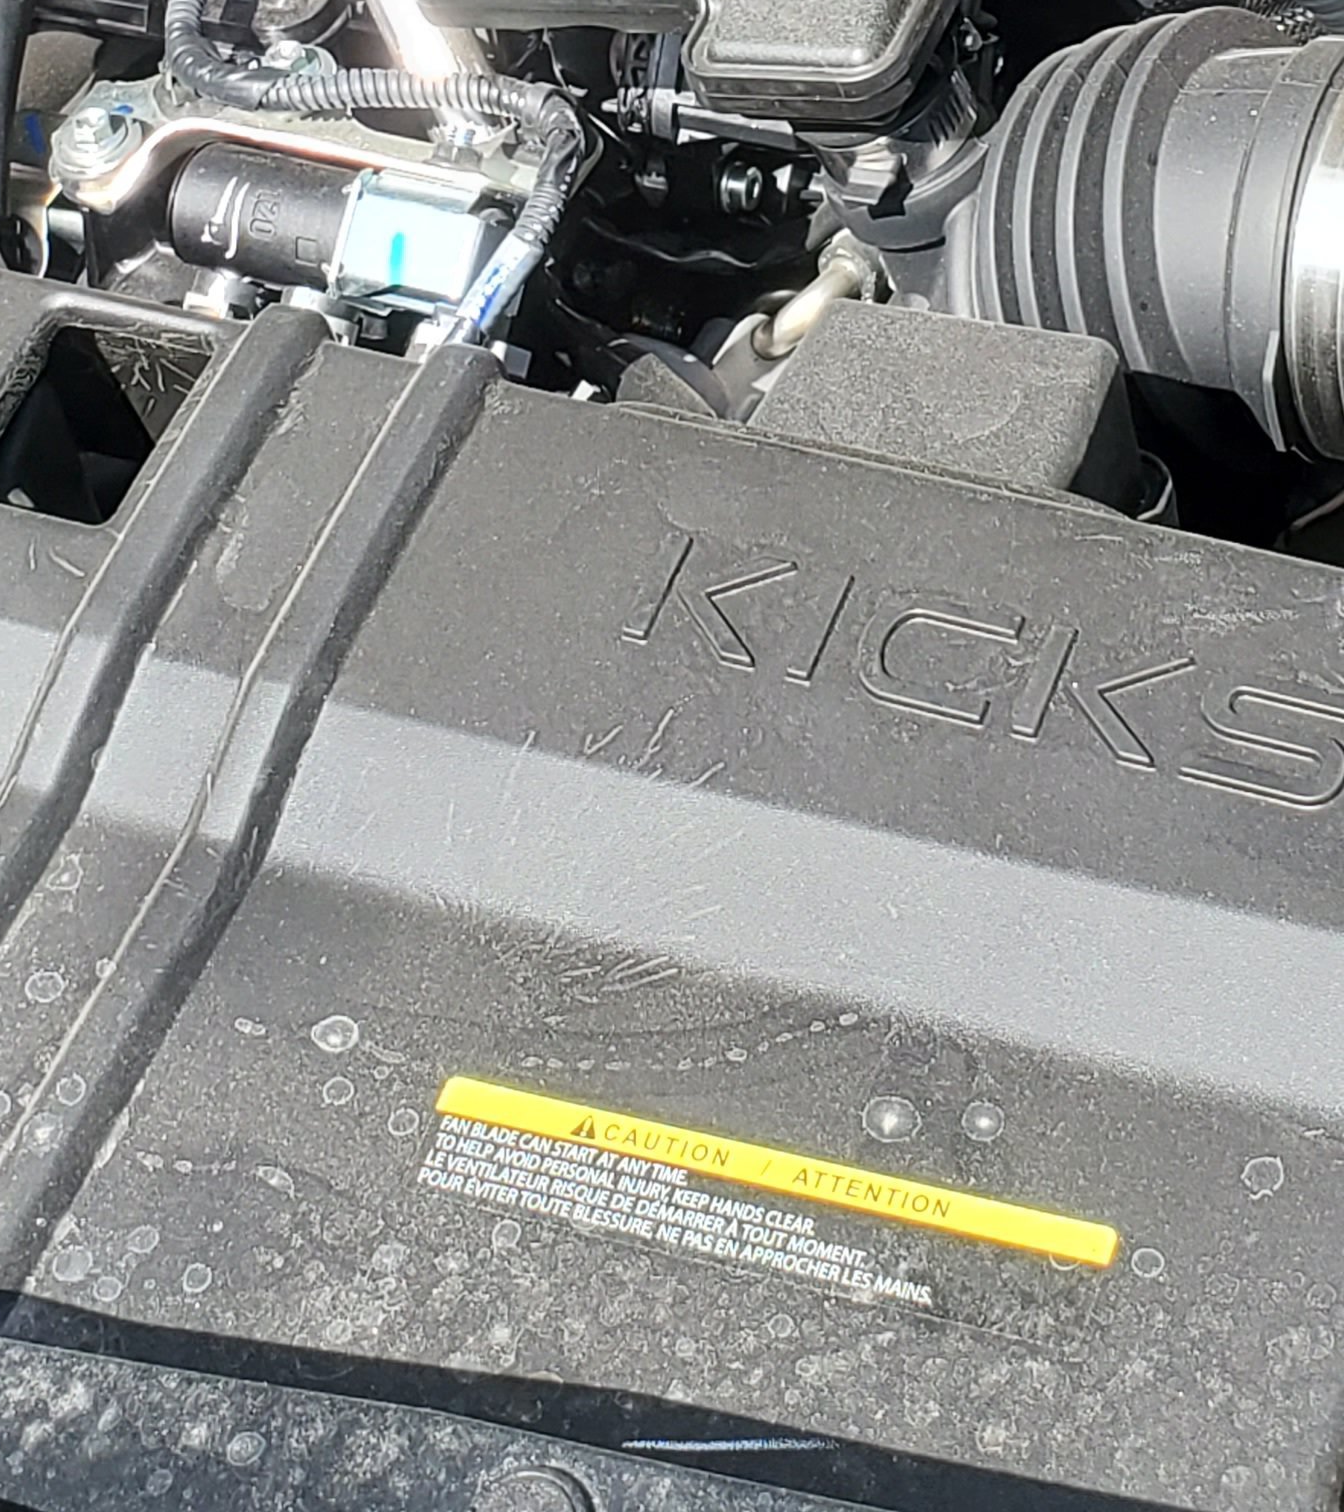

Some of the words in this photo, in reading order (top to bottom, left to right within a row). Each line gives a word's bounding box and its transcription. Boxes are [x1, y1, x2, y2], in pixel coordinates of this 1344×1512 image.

[434, 1131, 457, 1151] TO
[455, 1136, 495, 1160] HELP
[493, 1144, 542, 1171] AVOID
[539, 1155, 617, 1189] PERSONAL
[670, 1185, 711, 1211] KEEP
[709, 1194, 765, 1224] HANDS
[763, 1207, 818, 1236] CLEAR.
[439, 1113, 470, 1135] FAN
[469, 1120, 519, 1146] BLADE
[517, 1131, 552, 1154] CAN
[551, 1139, 598, 1165] START
[595, 1150, 619, 1170] AT
[601, 1121, 732, 1170] CAUTION
[791, 1164, 953, 1222] ATTENTION
[415, 1165, 464, 1193] POUR
[462, 1173, 520, 1206] ÉVITER
[517, 1189, 574, 1219] TOUTE
[654, 1221, 682, 1244] NE
[681, 1228, 716, 1252] PAS
[714, 1236, 740, 1257] EN
[738, 1240, 842, 1283] APPROCHER
[840, 1265, 873, 1290] LES
[423, 1147, 447, 1168] LE
[444, 1151, 551, 1194] VENTILATEUR
[548, 1176, 610, 1209] RISQUE
[609, 1191, 636, 1213] DE
[634, 1194, 726, 1236] DÉMARRER
[724, 1216, 741, 1238] À
[738, 1222, 788, 1249] TOUT
[785, 1232, 868, 1269] MOMENT.
